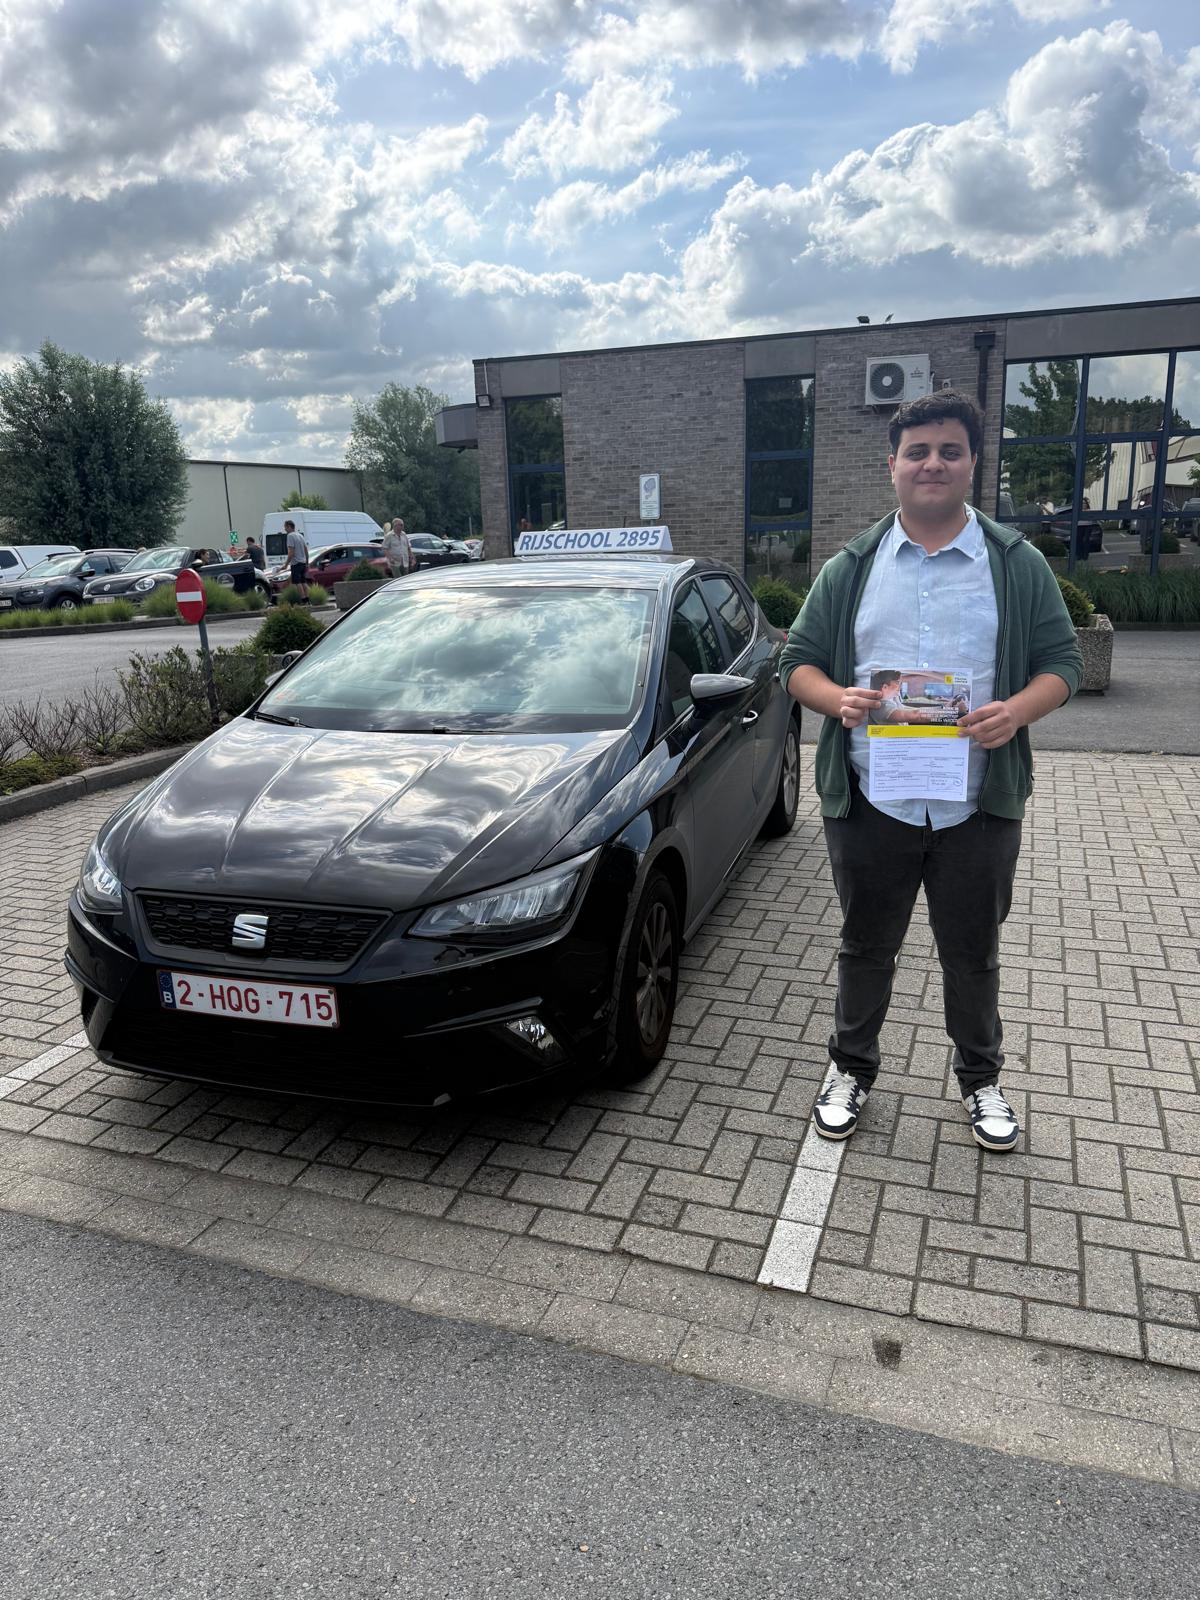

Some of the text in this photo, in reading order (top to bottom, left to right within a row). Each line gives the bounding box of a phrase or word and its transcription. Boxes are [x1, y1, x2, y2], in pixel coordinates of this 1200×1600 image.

[519, 529, 661, 550] RIJSCHOOL 2895
[162, 979, 333, 1021] B 2-HQG-715
